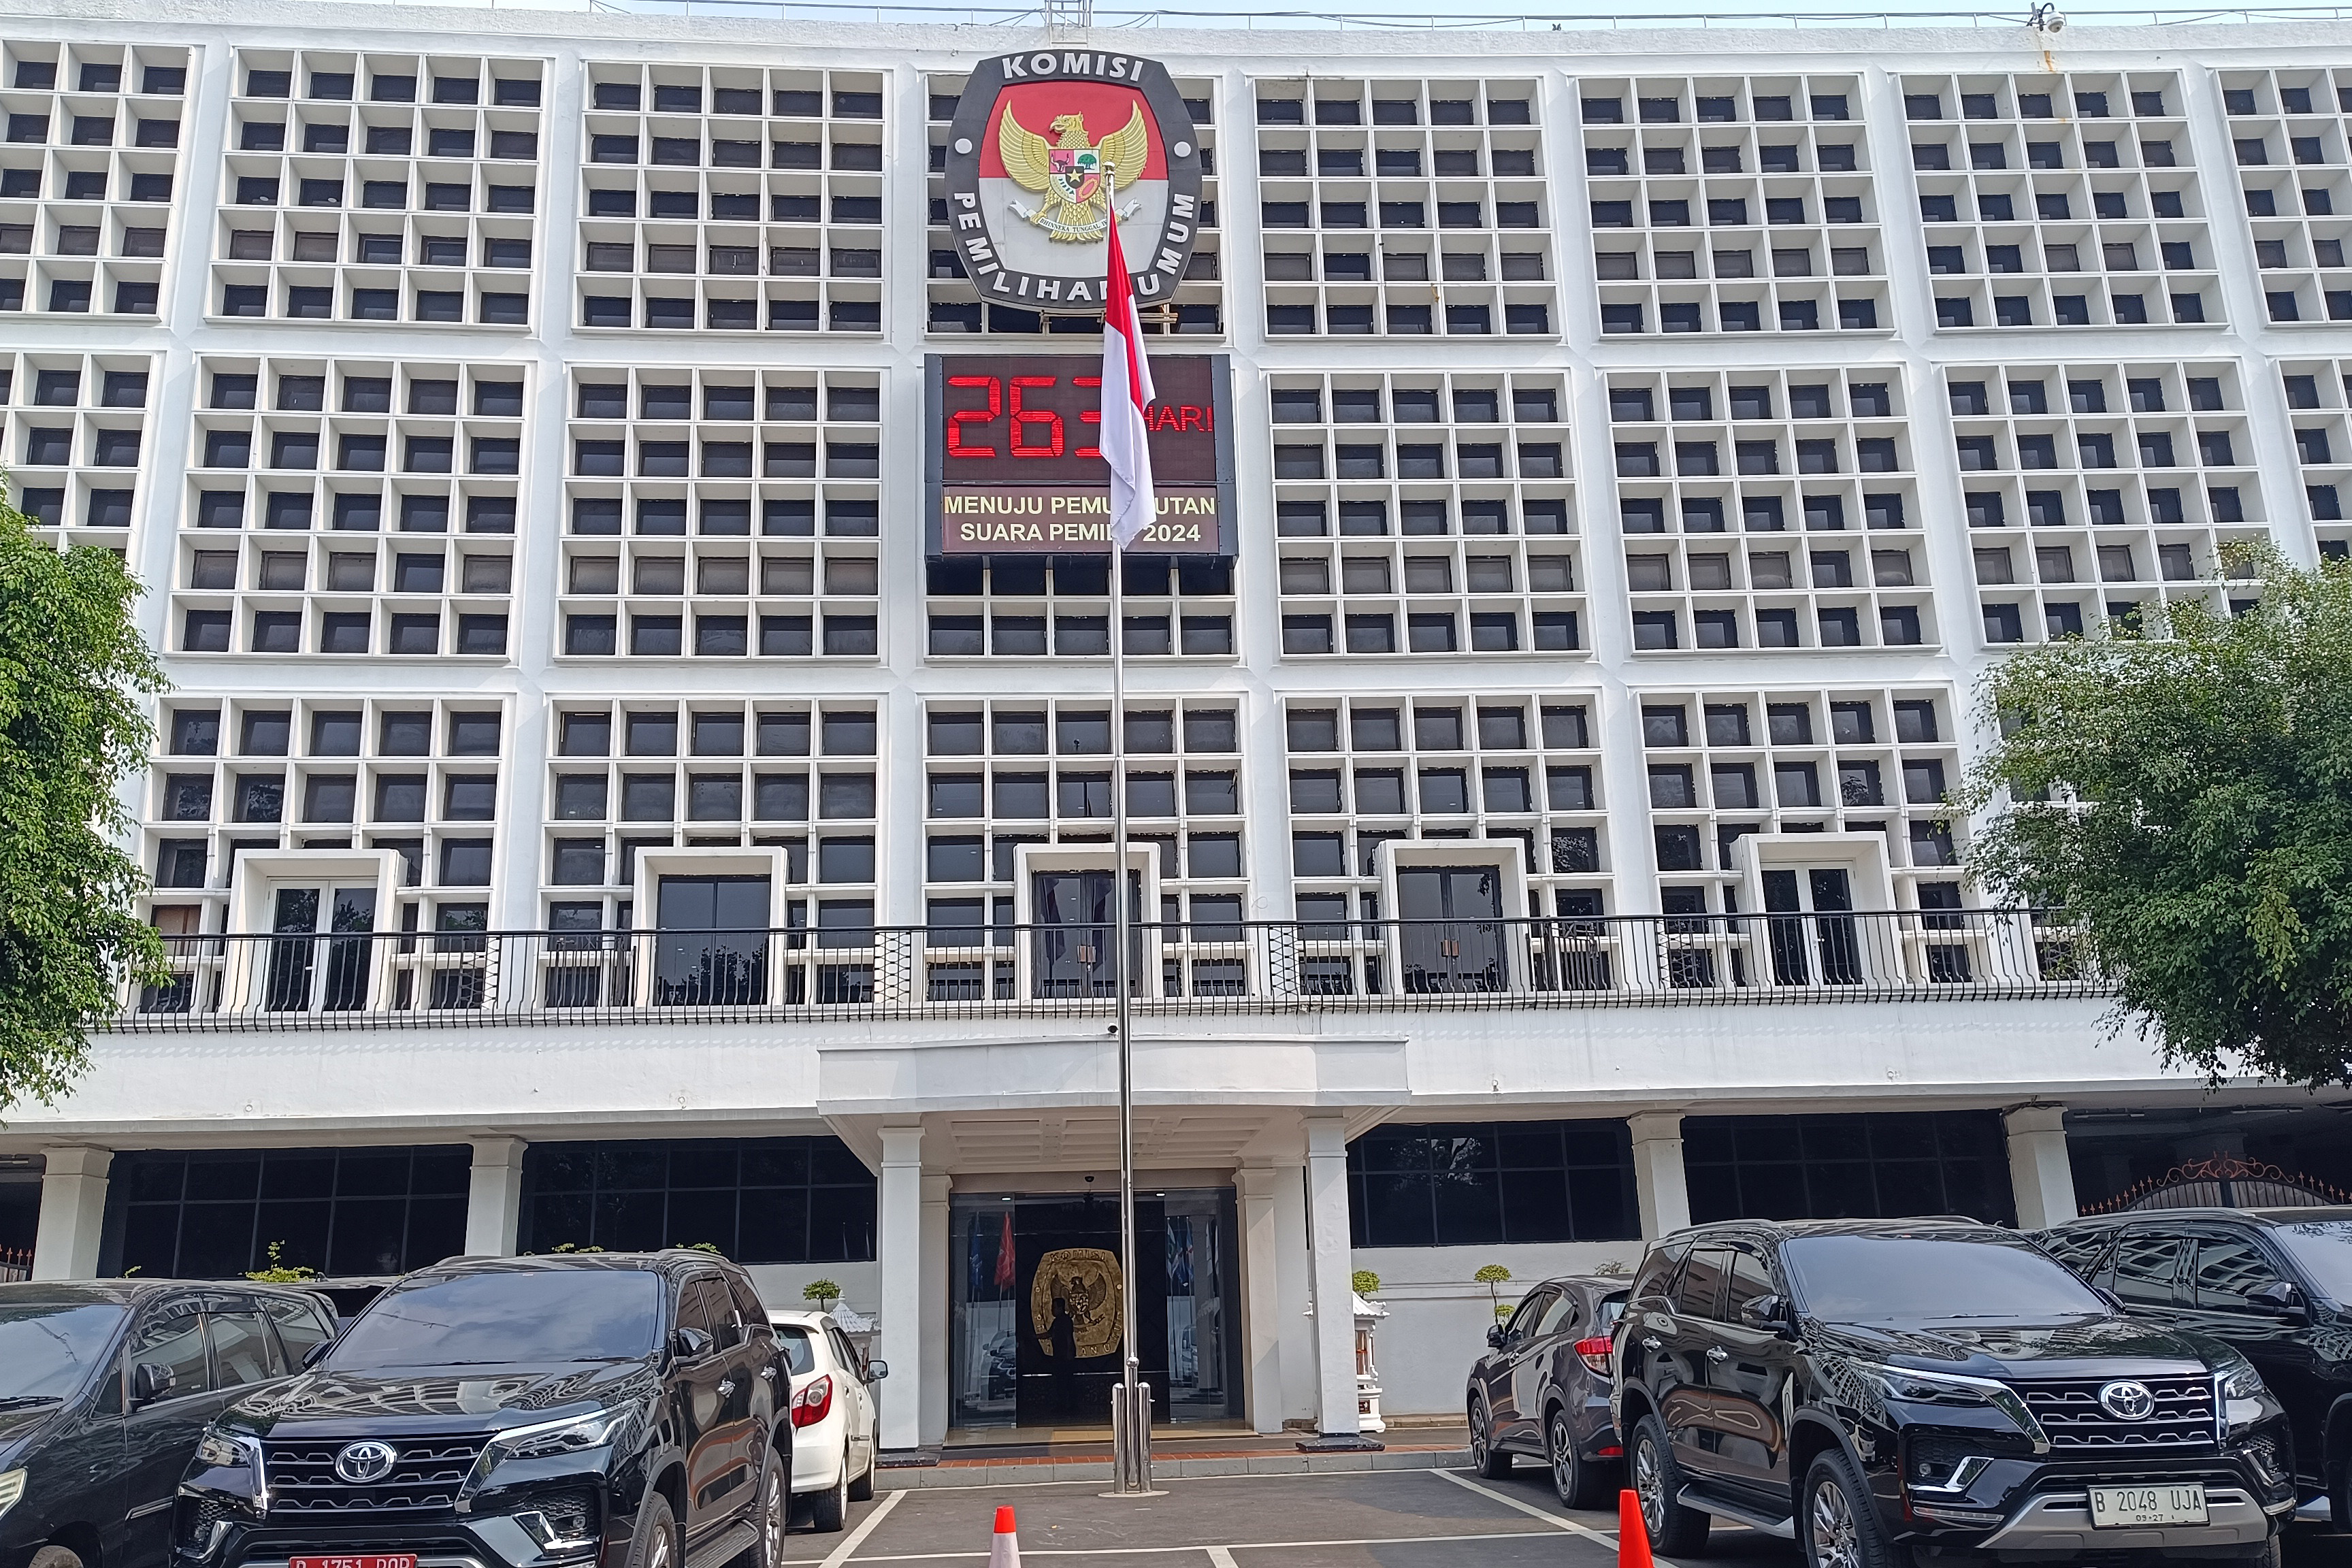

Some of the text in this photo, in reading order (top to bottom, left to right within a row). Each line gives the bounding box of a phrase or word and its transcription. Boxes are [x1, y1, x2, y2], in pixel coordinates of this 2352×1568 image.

[1002, 52, 1143, 82] KOMISI
[1040, 218, 1101, 233] BHINNEKA TUNGGAL
[1137, 193, 1195, 295] UMUM
[944, 496, 1043, 515] MENUJU
[960, 523, 1043, 542] SUARA
[1143, 524, 1201, 542] 2024
[1051, 1250, 1105, 1262] KOMISI
[2095, 1490, 2202, 1513] B 2048 UJA
